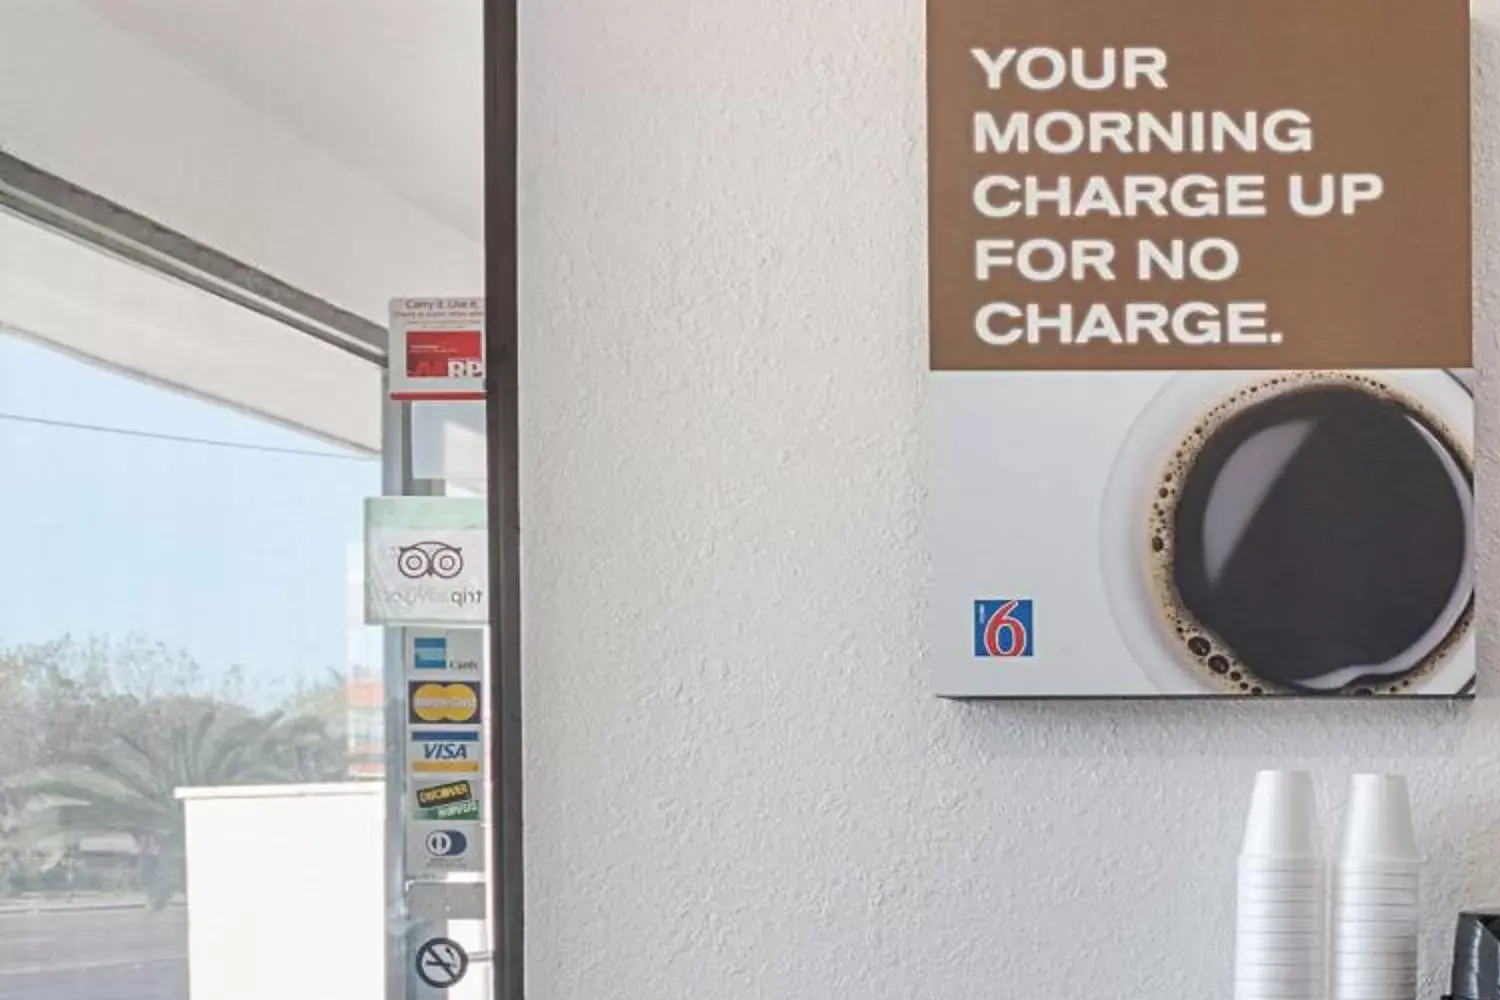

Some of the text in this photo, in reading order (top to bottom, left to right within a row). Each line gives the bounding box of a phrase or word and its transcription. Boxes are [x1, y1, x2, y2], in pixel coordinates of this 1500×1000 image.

[970, 46, 1168, 91] YOUR
[973, 108, 1312, 154] MORNING
[972, 173, 1384, 218] CHARGE UP
[975, 237, 1240, 282] FOR NO
[974, 301, 1284, 346] CHARGE.
[983, 599, 1027, 657] 6
[423, 743, 468, 760] VISA
